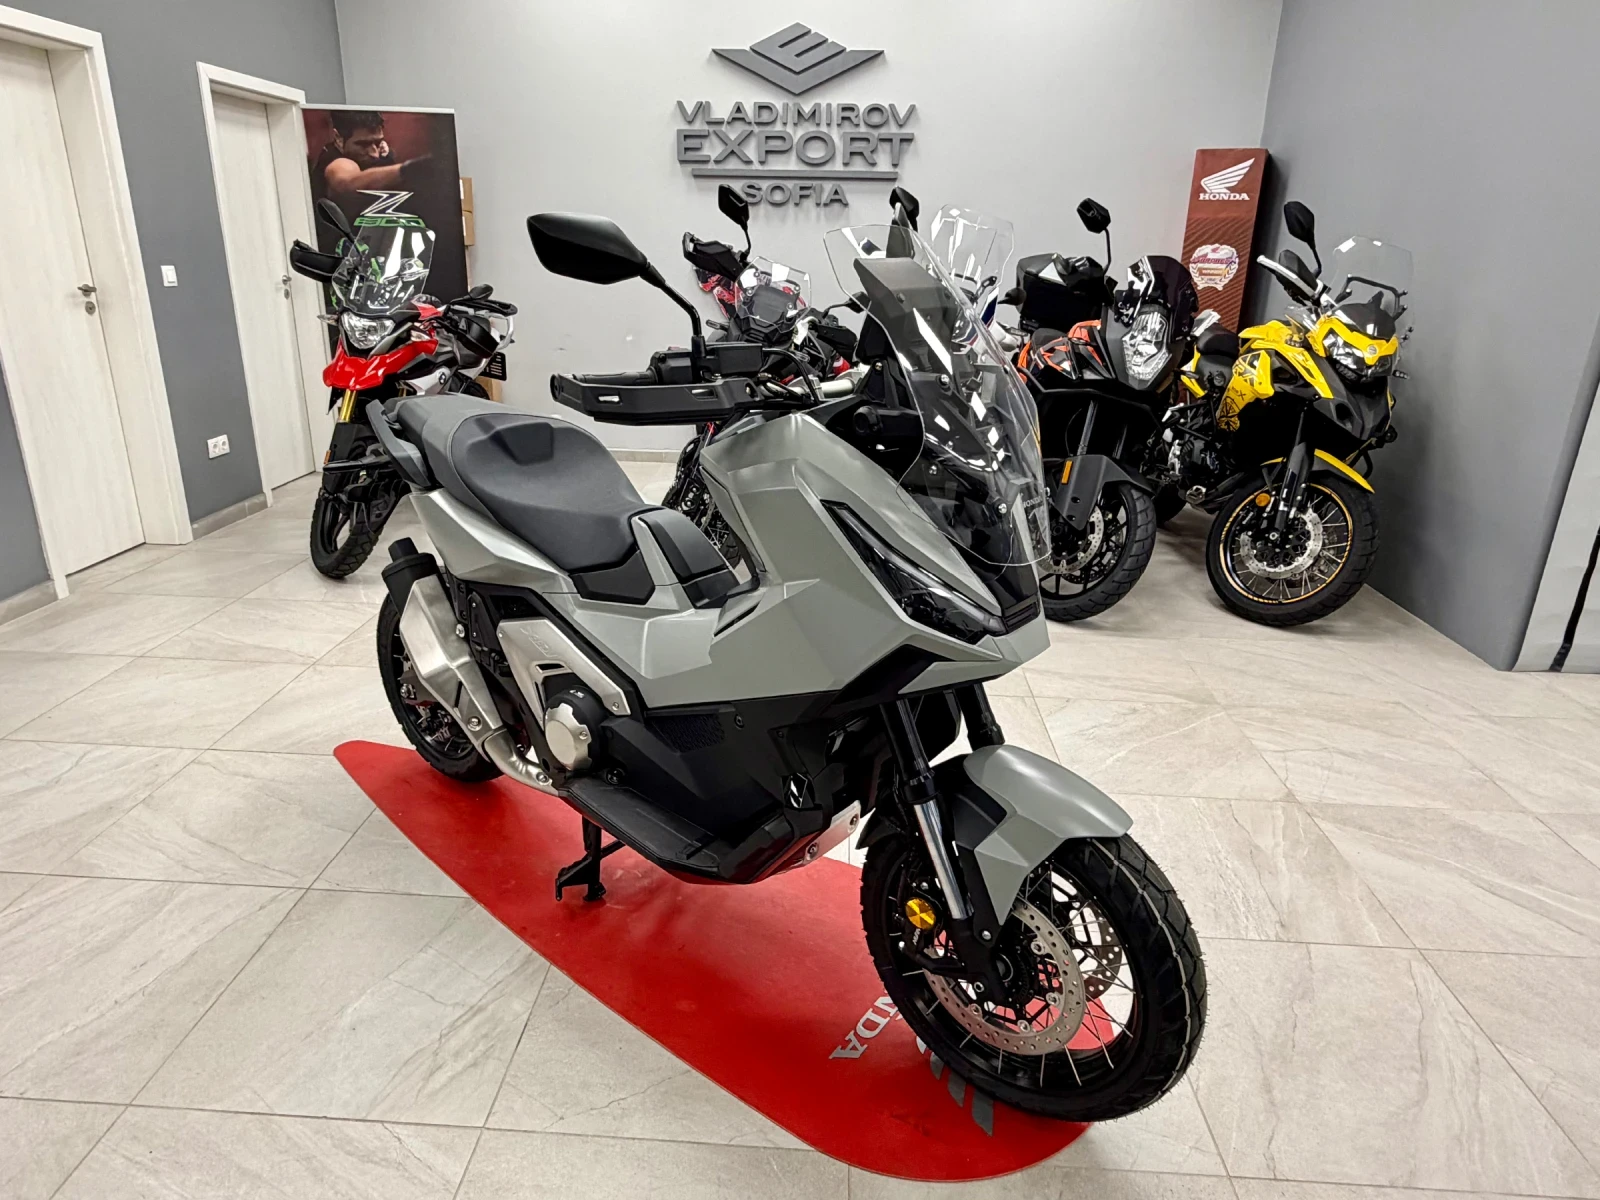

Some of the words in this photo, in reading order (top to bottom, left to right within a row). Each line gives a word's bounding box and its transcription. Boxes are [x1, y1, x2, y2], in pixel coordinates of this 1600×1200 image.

[676, 100, 916, 127] VLADIMIROV
[676, 129, 915, 167] EXPORT
[741, 182, 849, 207] SOFIA
[1198, 192, 1251, 201] HONDA
[828, 989, 899, 1060] NDA
